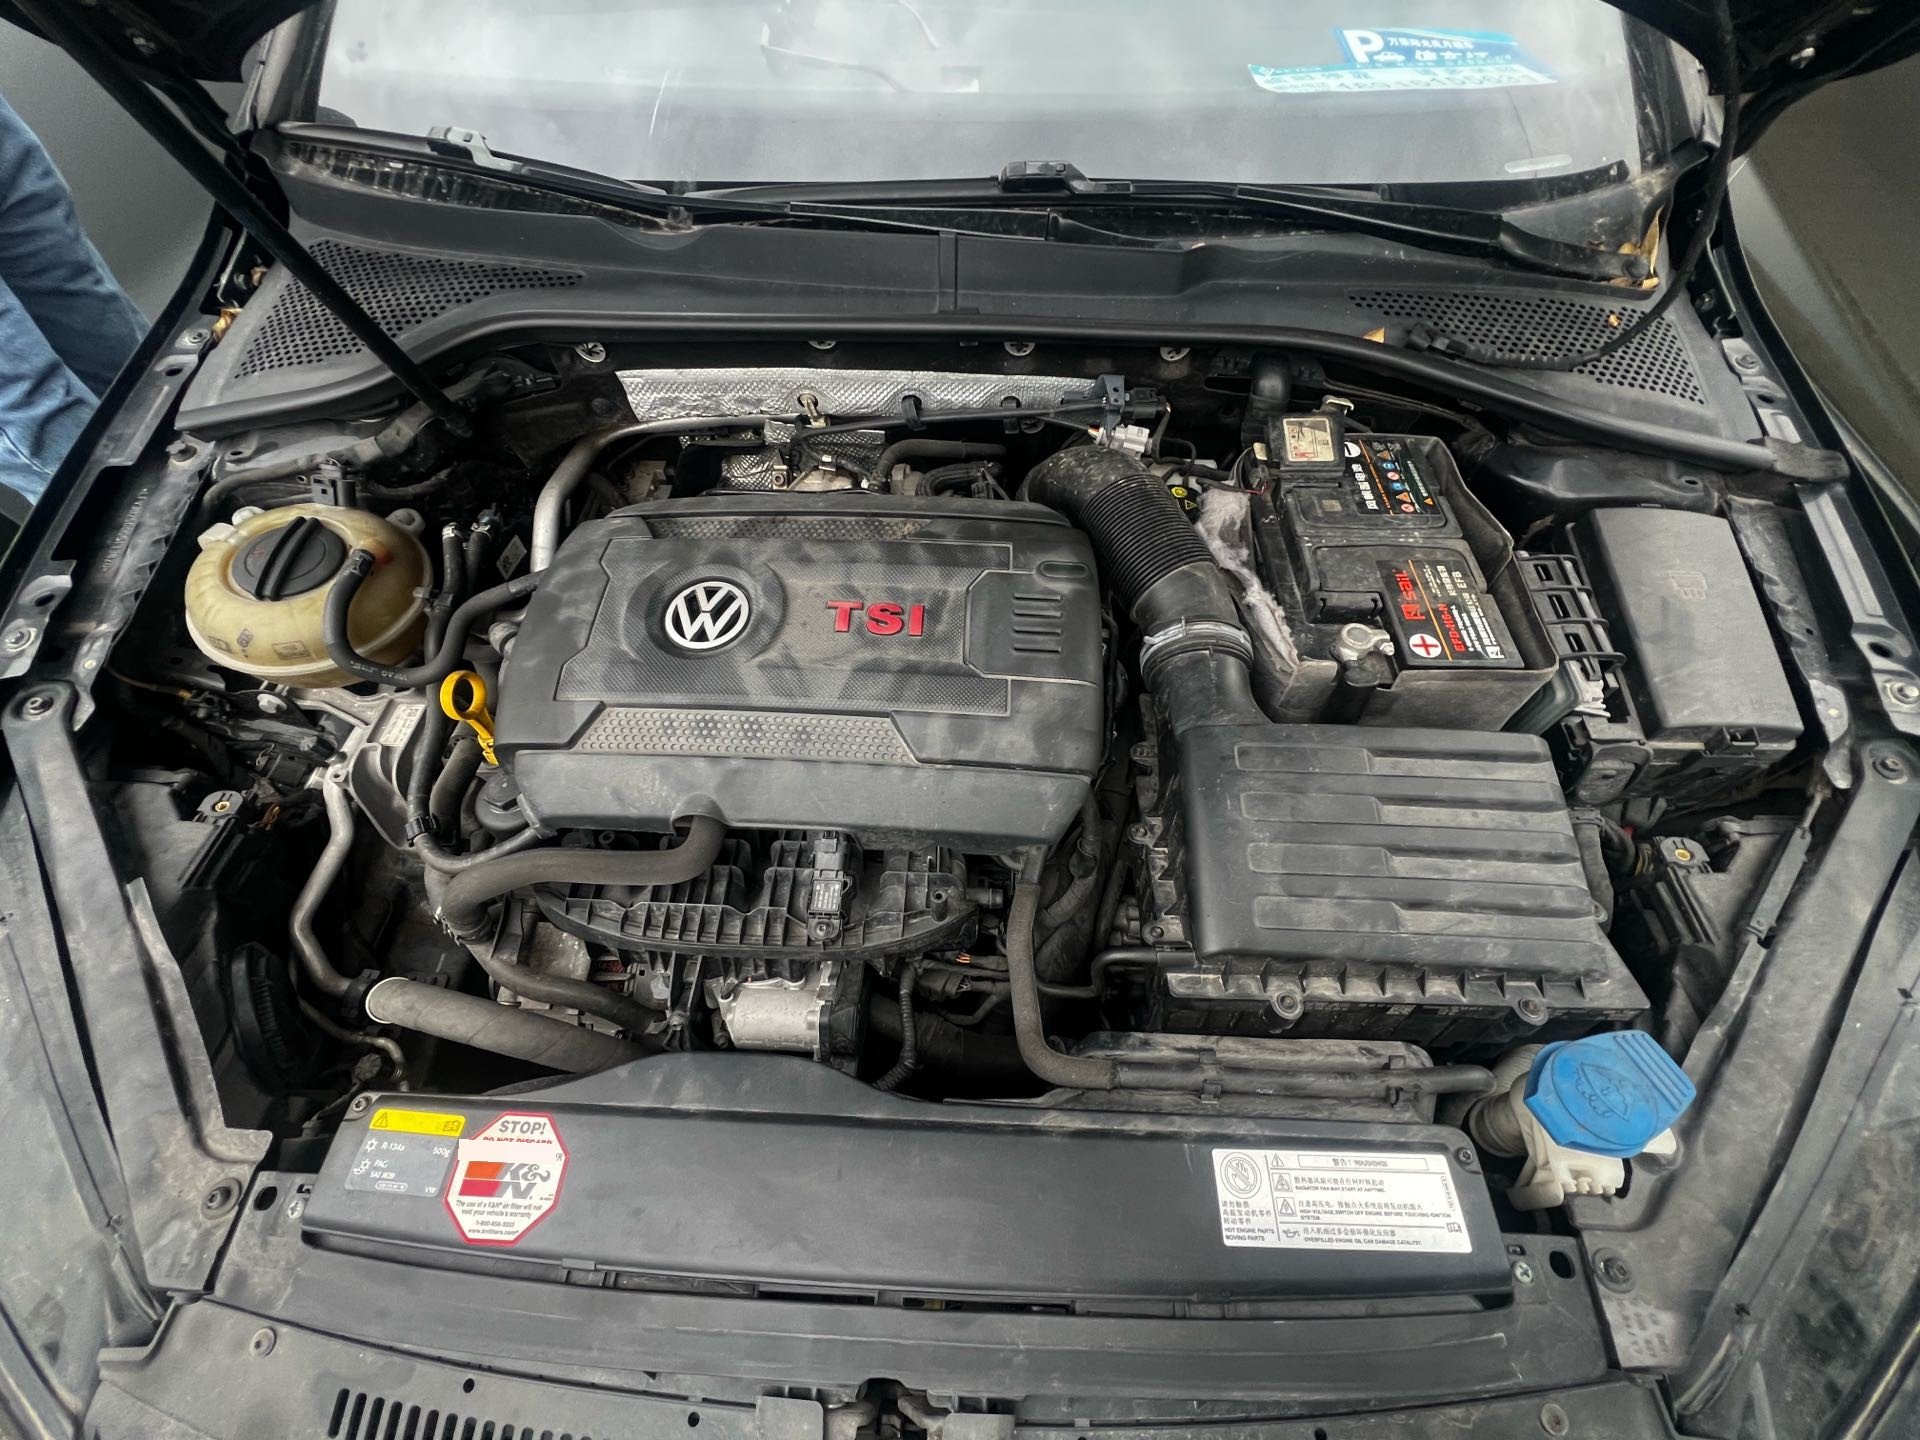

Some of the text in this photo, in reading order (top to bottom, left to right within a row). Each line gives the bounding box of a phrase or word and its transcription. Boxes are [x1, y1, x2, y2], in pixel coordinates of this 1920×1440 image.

[1343, 29, 1385, 64] P
[826, 600, 926, 638] TSI
[498, 1119, 547, 1135] STOP!
[456, 1199, 466, 1207] The
[510, 1202, 523, 1210] filter
[473, 1209, 486, 1217] your
